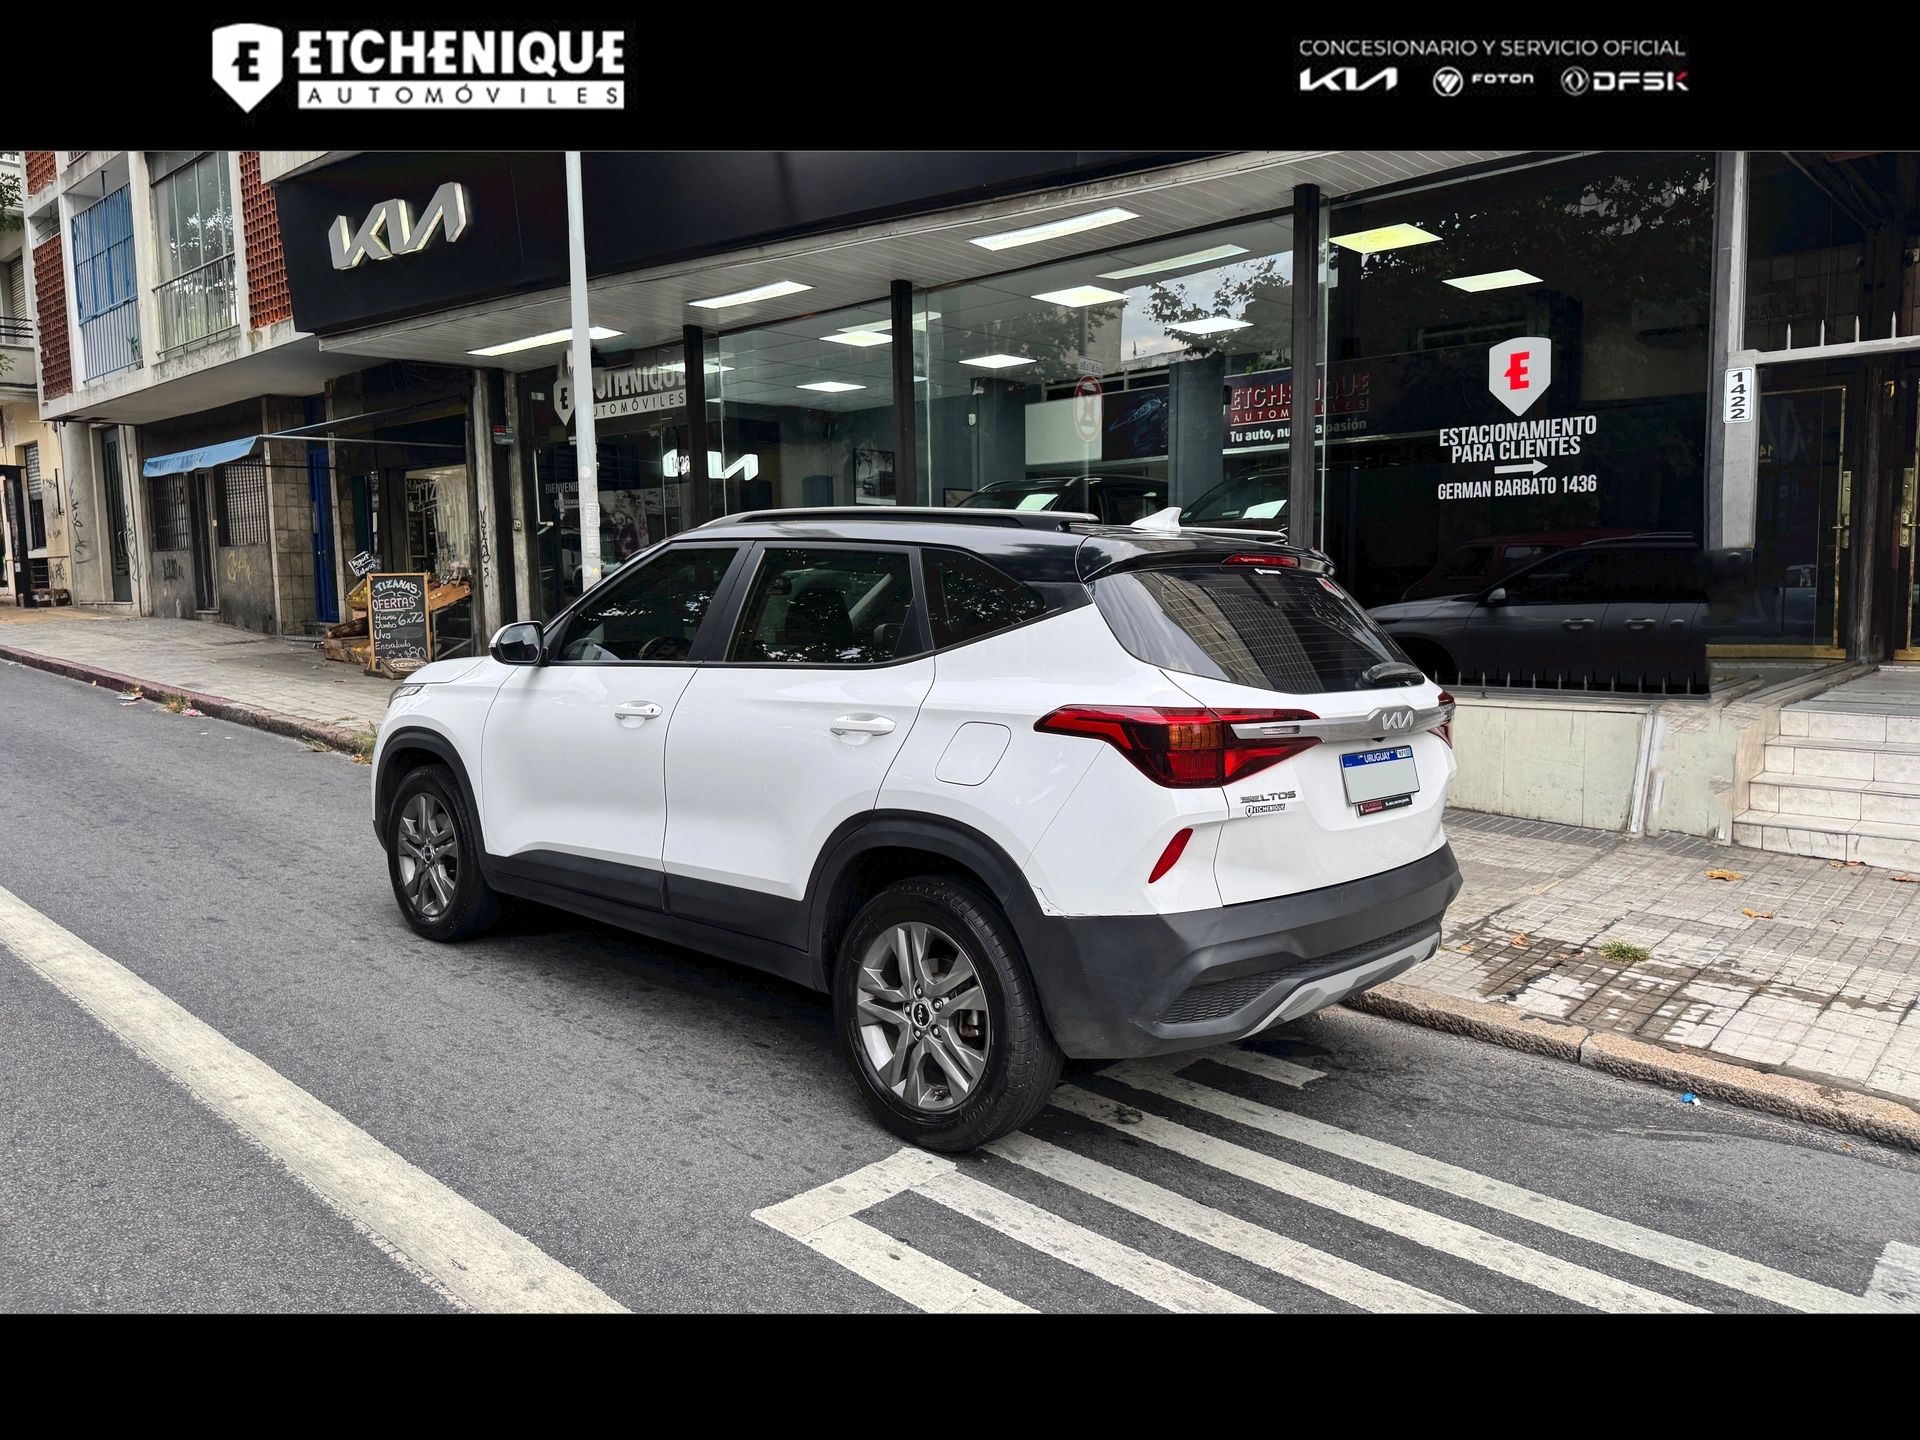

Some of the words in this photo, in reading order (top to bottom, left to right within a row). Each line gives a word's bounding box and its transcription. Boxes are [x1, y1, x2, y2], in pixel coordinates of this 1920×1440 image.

[328, 182, 467, 270] KIA
[1730, 371, 1747, 420] 1422
[1230, 430, 1243, 443] Tu
[1245, 429, 1275, 442] auto,
[1439, 415, 1597, 447] ESTACIONAMIENTO
[1452, 443, 1495, 464] PARA
[1499, 435, 1581, 460] CLIENTES
[1437, 480, 1492, 500] GERMAN
[1494, 477, 1557, 497] BARBATO
[1561, 474, 1598, 494] 1436
[372, 597, 416, 610] OFERTAS
[374, 629, 391, 640] Uva
[1382, 710, 1414, 731] KIA
